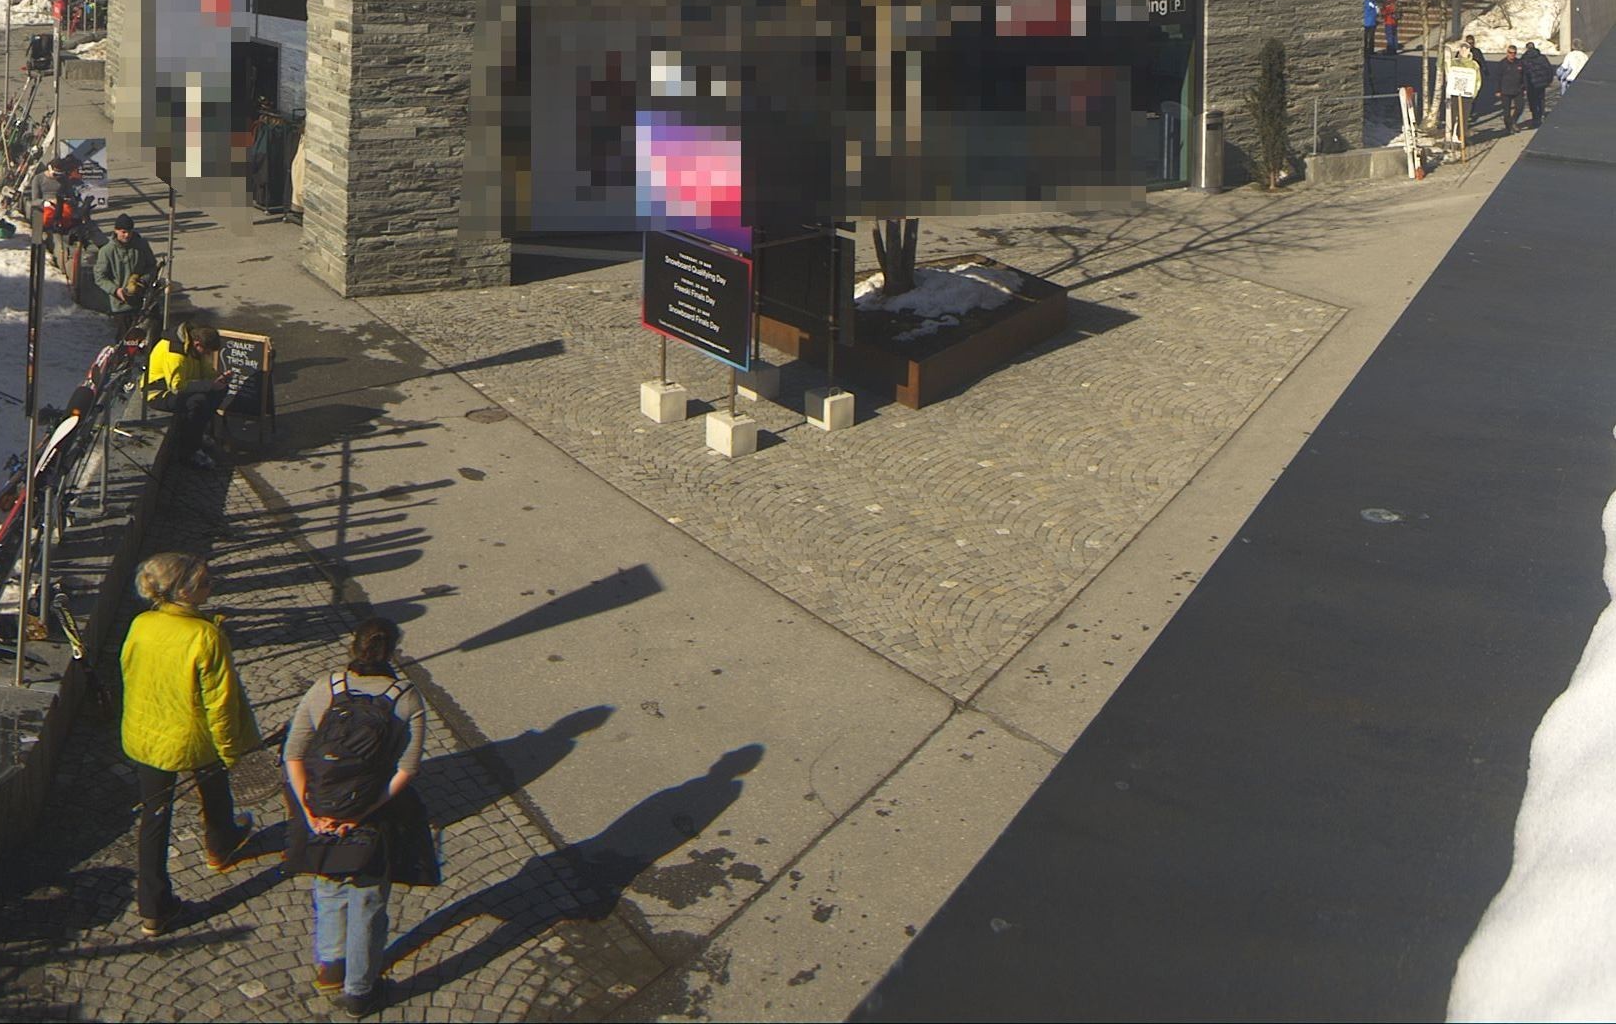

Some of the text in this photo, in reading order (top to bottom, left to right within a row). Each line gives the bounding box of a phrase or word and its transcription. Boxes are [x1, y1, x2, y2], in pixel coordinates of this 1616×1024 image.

[664, 255, 692, 272] Snowboard
[716, 274, 728, 287] Day
[705, 295, 716, 307] Day
[709, 321, 720, 333] Day
